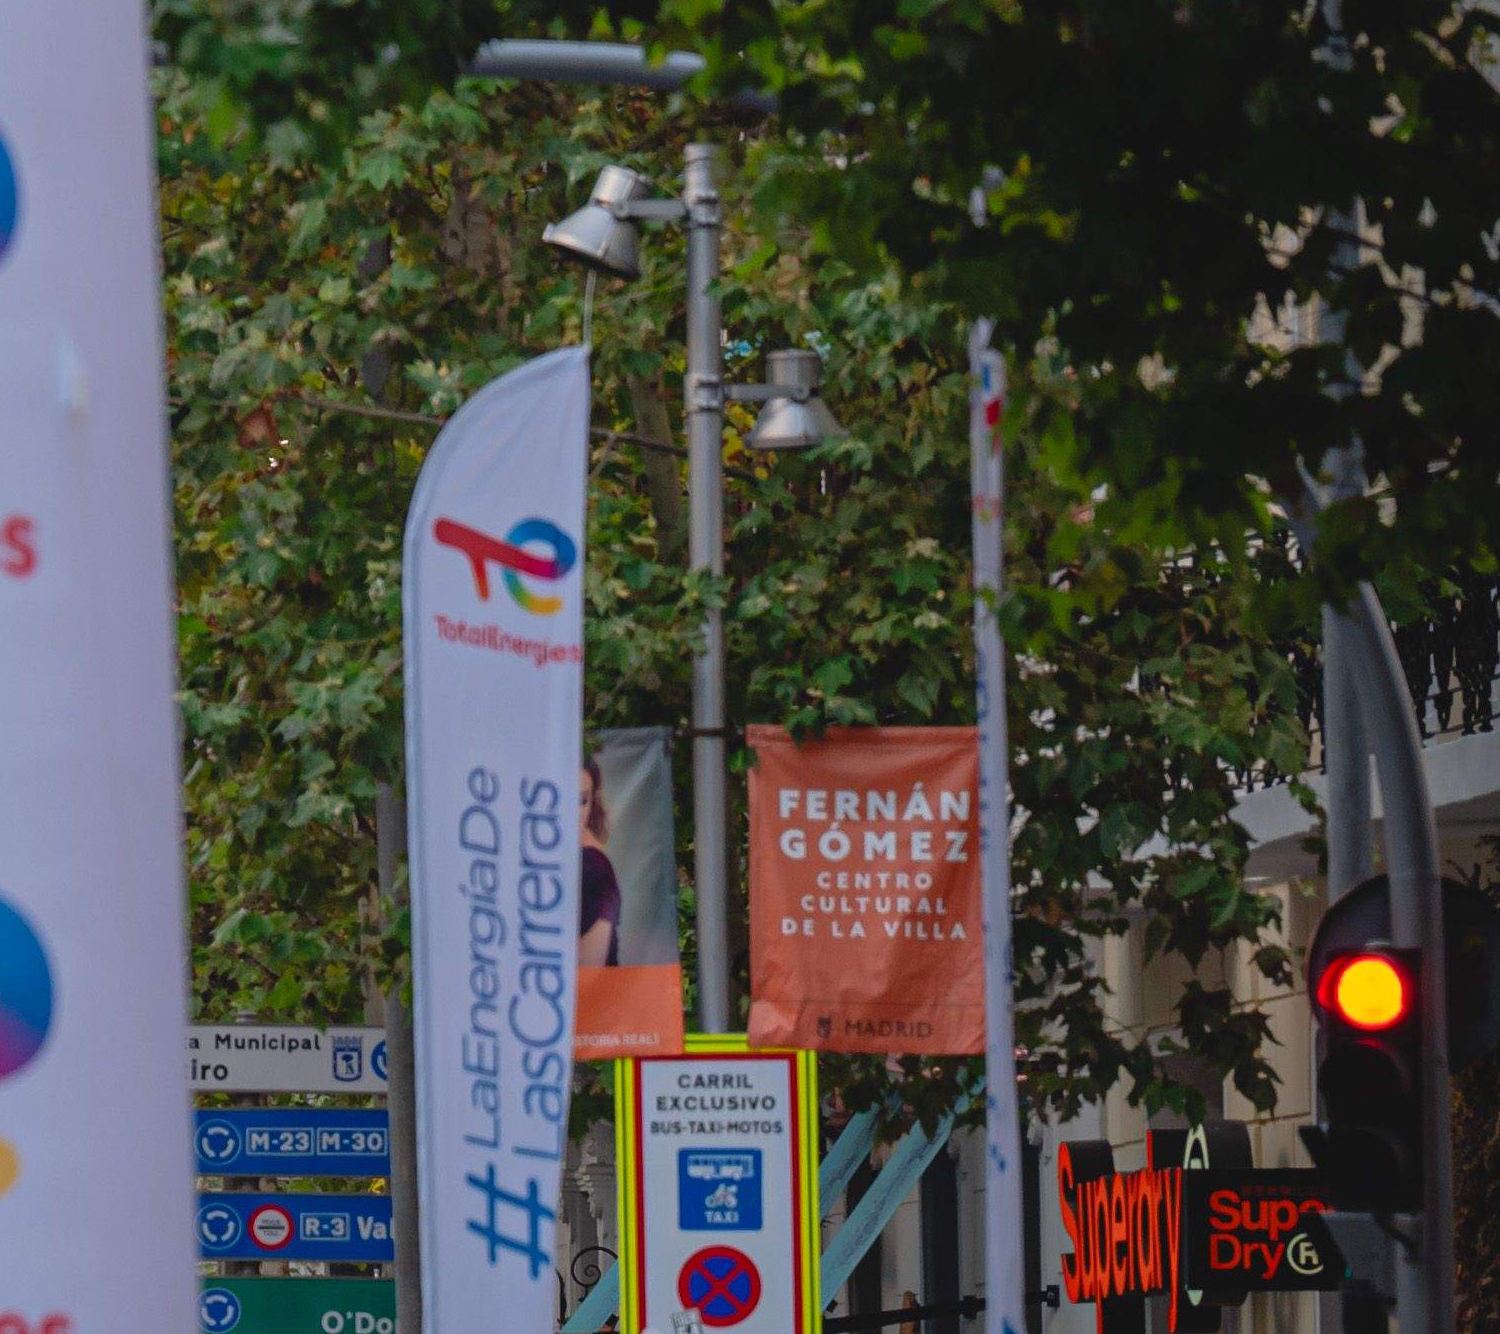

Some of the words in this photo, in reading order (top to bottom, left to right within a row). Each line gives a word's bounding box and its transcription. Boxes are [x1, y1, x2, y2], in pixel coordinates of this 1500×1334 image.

[778, 781, 971, 821] FERNÁN
[779, 821, 969, 862] GÓMEZ
[816, 870, 934, 890] CENTRO
[801, 893, 948, 915] CULTURAL
[780, 917, 815, 937] DE
[831, 920, 867, 939] LA
[883, 920, 968, 941] VILLA
[844, 1018, 934, 1039] MADRID
[214, 1032, 322, 1052] Municipal
[190, 1060, 229, 1082] iro
[677, 1074, 753, 1089] CARRIL
[656, 1096, 776, 1111] EXCLUSIVO
[650, 1120, 784, 1134] BUS-TAXI-MOTOS
[249, 1131, 311, 1152] M-23
[320, 1131, 383, 1152] M-30
[304, 1216, 346, 1237] R-3
[704, 1211, 739, 1223] TAXI
